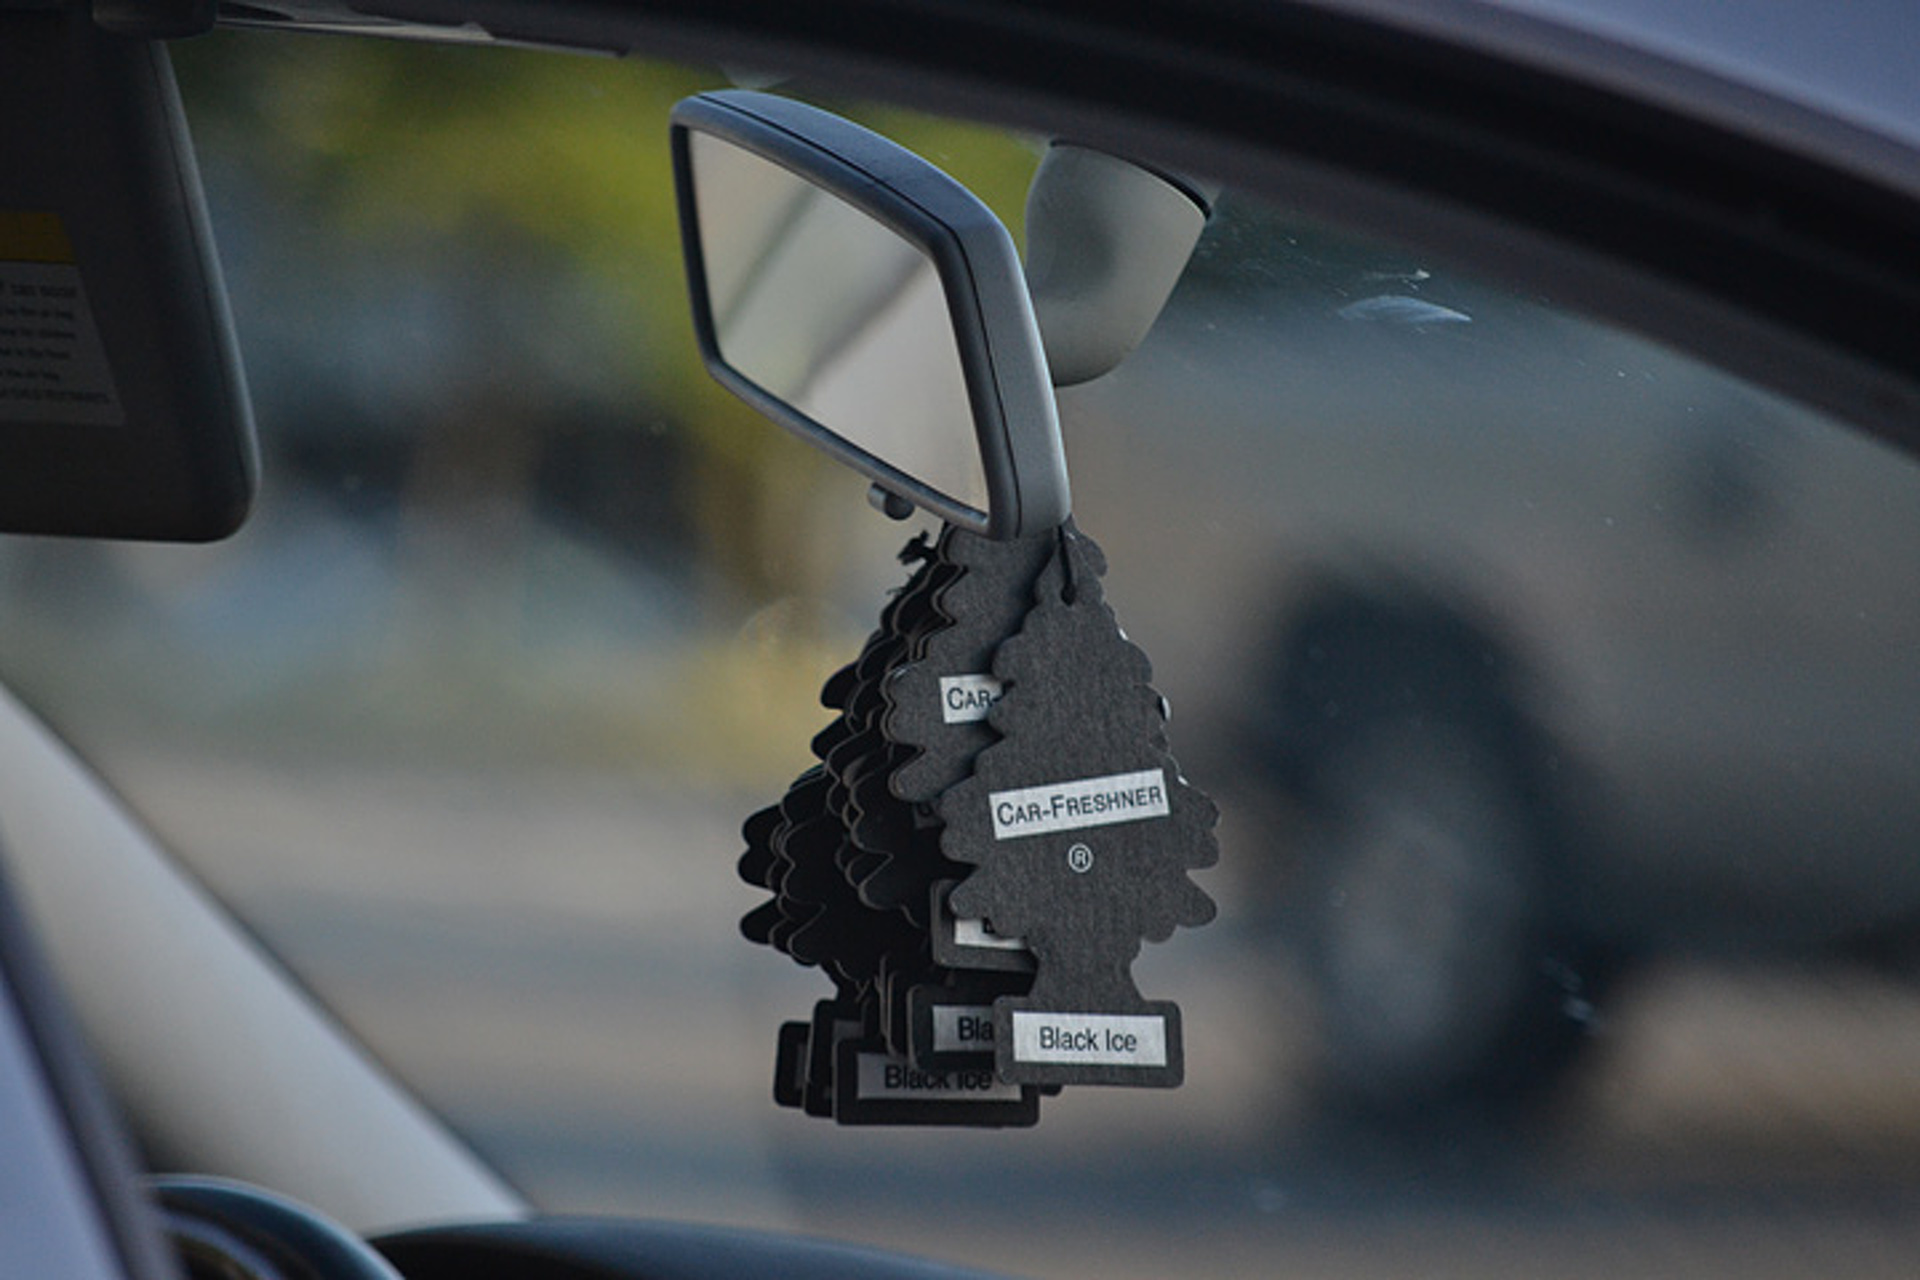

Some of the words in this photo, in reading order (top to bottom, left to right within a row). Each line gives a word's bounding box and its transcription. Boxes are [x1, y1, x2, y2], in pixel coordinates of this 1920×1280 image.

[996, 786, 1164, 826] CAR-FRESHNER
[1039, 1026, 1099, 1051] Black
[1106, 1028, 1137, 1051] Ice
[884, 1065, 949, 1089] Black
